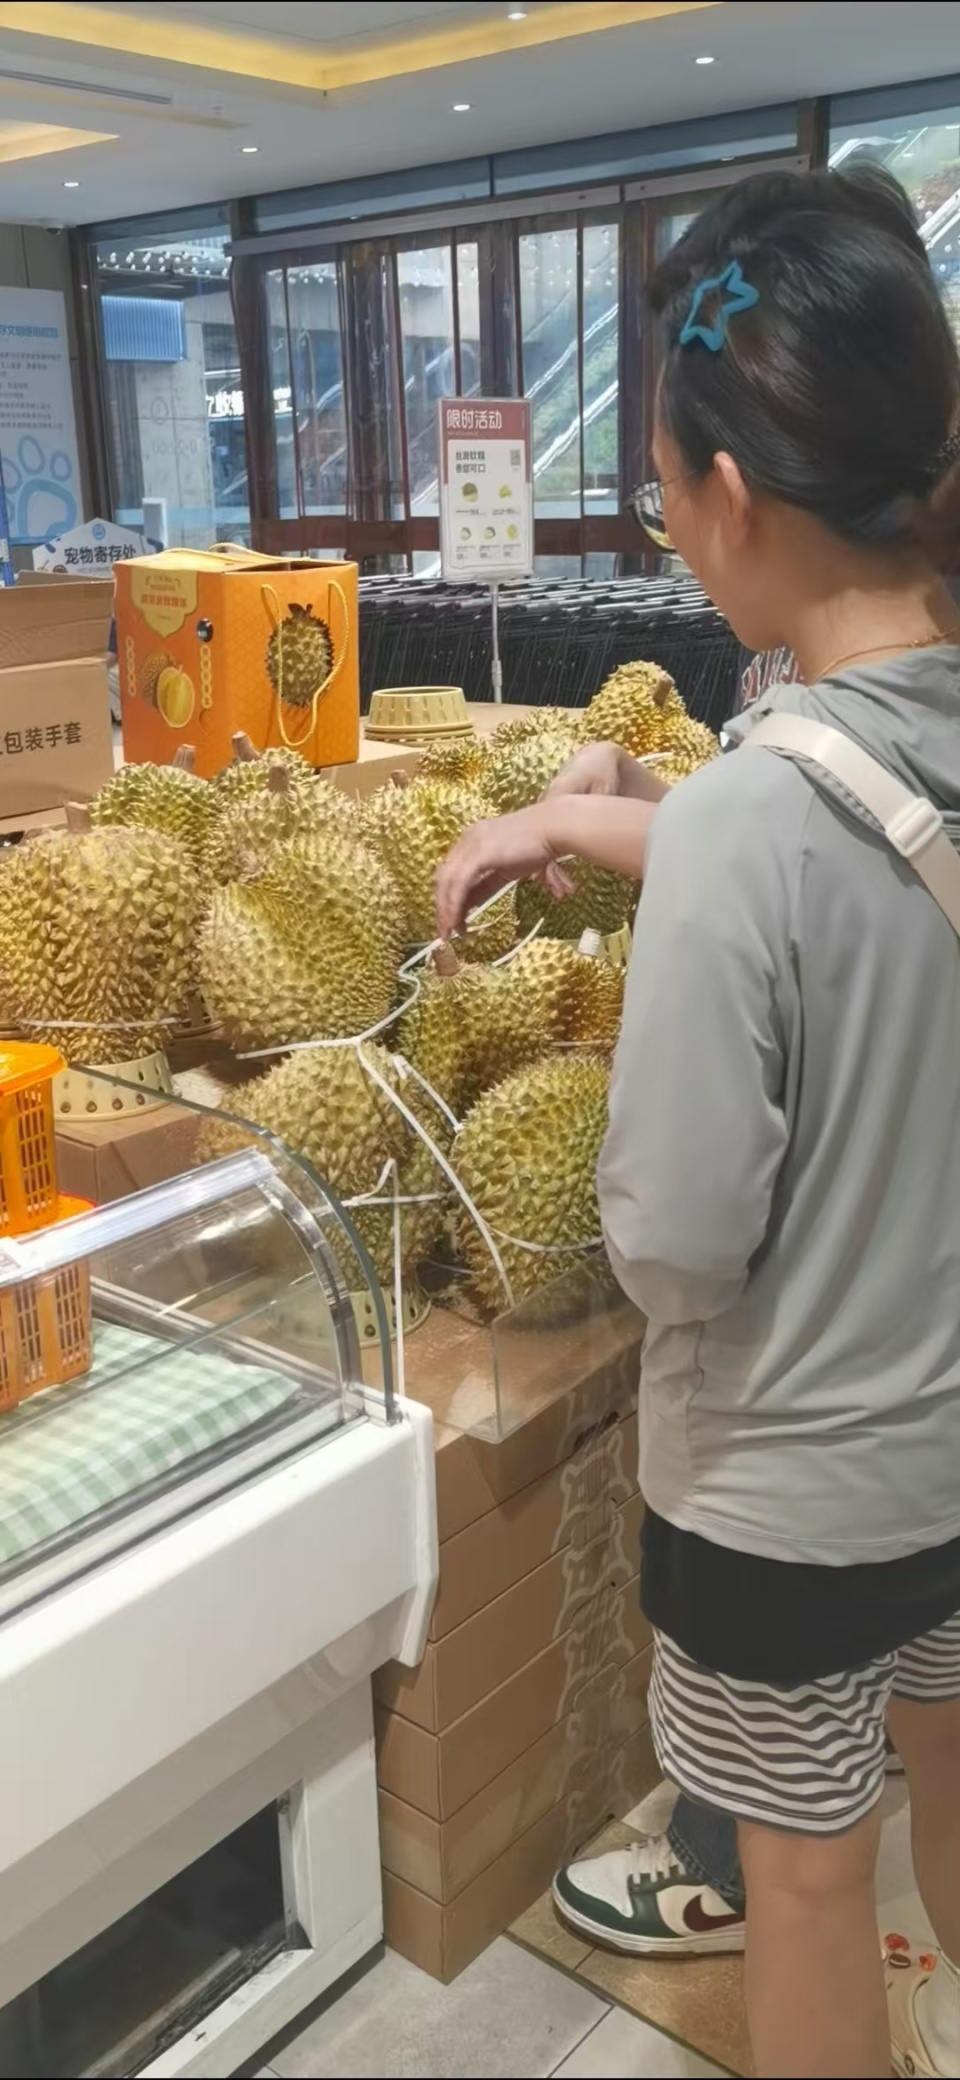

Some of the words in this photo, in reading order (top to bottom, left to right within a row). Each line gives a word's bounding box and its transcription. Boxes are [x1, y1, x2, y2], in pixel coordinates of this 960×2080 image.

[446, 408, 502, 429] 限时活动
[64, 544, 136, 565] 宠物寄存处
[0, 721, 82, 755] 包装手套
